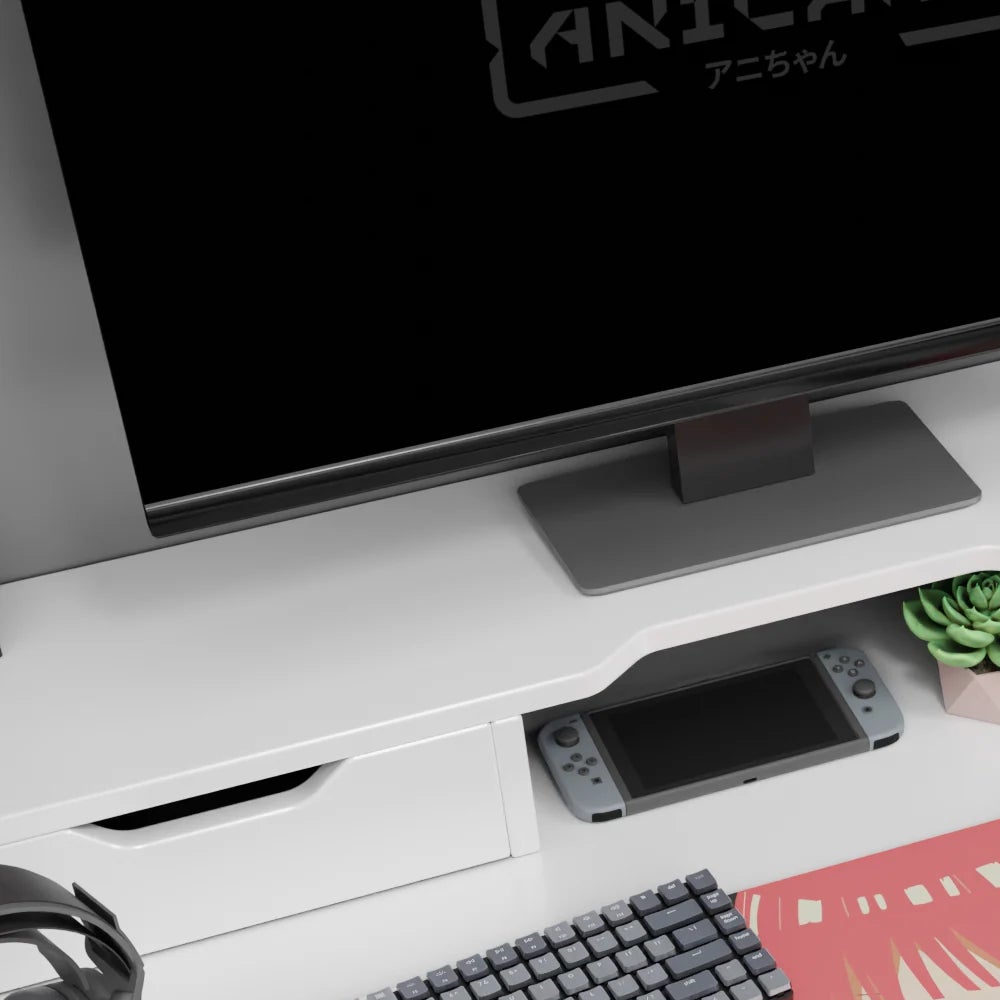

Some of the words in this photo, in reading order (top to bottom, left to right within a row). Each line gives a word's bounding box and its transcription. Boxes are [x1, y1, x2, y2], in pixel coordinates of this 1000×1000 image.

[705, 40, 847, 89] アニちゃん
